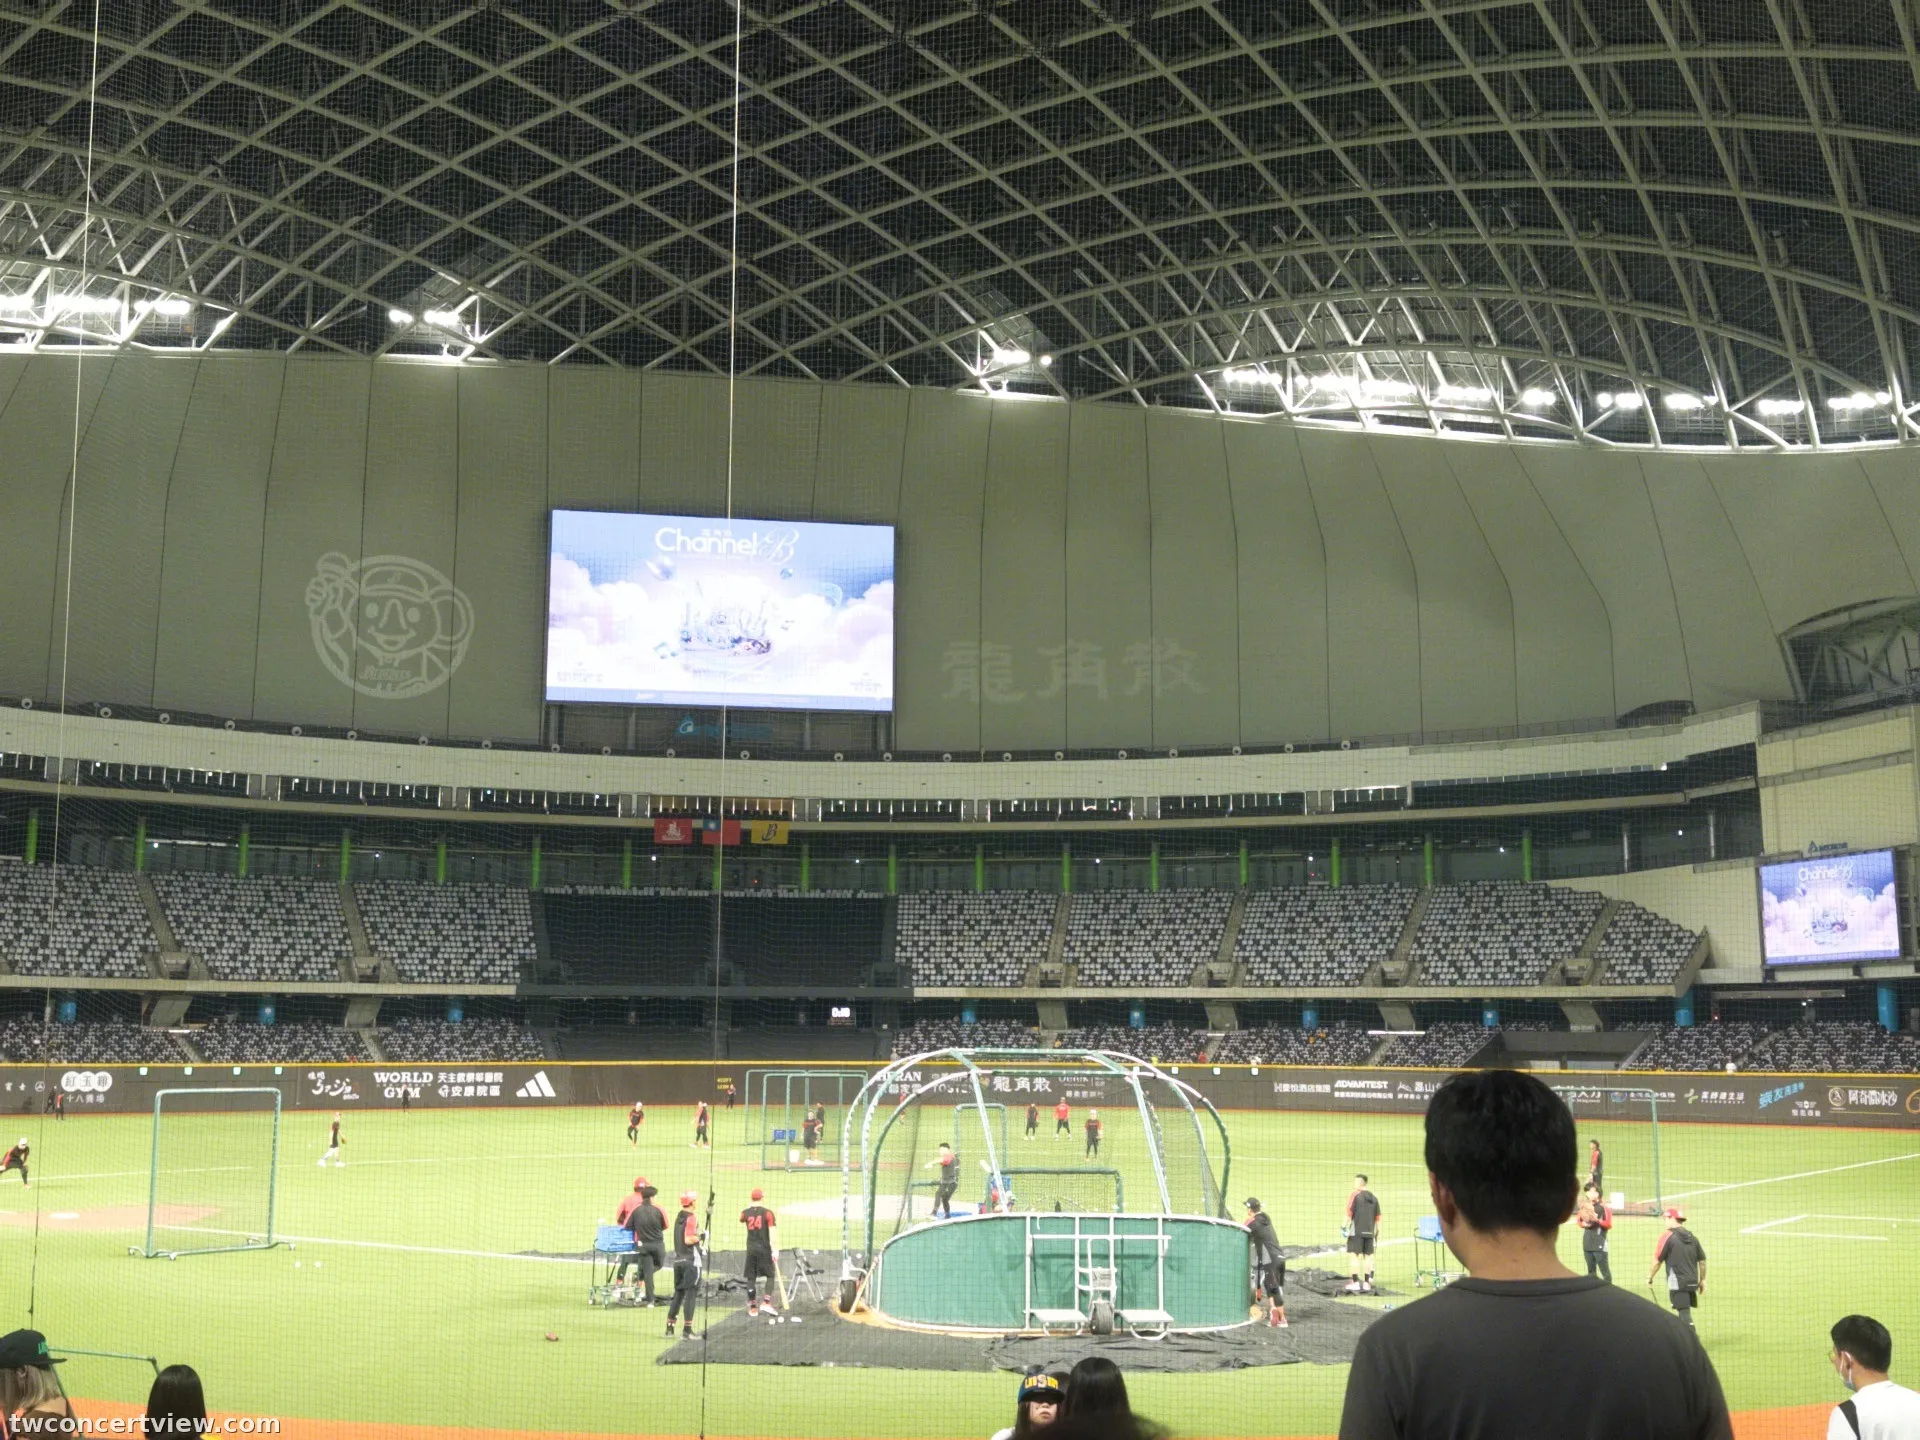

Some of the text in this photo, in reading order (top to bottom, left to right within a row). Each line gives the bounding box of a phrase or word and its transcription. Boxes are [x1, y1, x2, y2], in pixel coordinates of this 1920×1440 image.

[654, 526, 758, 556] Channel
[1798, 862, 1839, 882] Channel
[373, 1072, 434, 1083] WORLD
[992, 1076, 1053, 1093] 龍角散
[1333, 1079, 1389, 1090] ADVANTEST
[383, 1087, 421, 1098] GYM
[747, 1215, 763, 1231] 24
